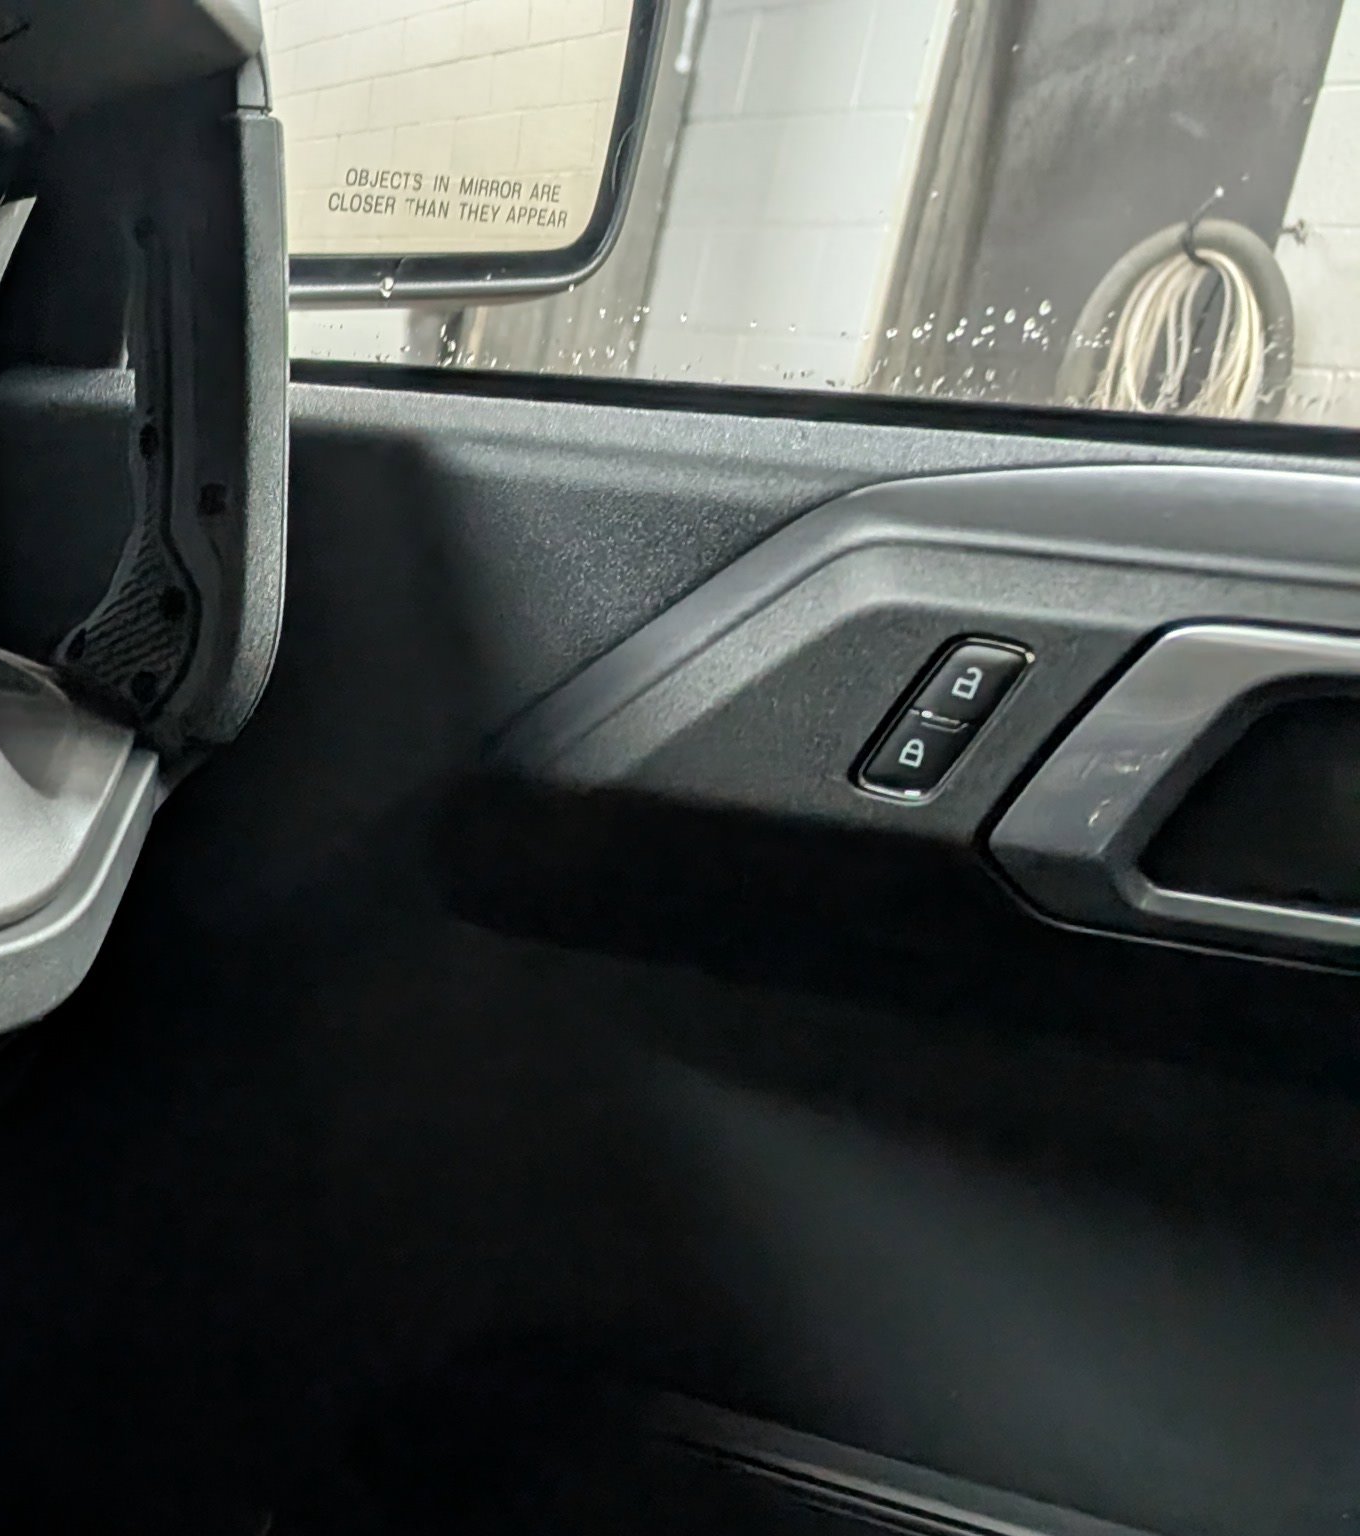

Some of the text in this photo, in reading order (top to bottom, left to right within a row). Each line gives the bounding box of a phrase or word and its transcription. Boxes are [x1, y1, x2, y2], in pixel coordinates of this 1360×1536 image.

[345, 167, 562, 203] OBJECTS IN MIRROR ARE
[327, 192, 568, 229] CLOSER THAN THEY APPEAR
